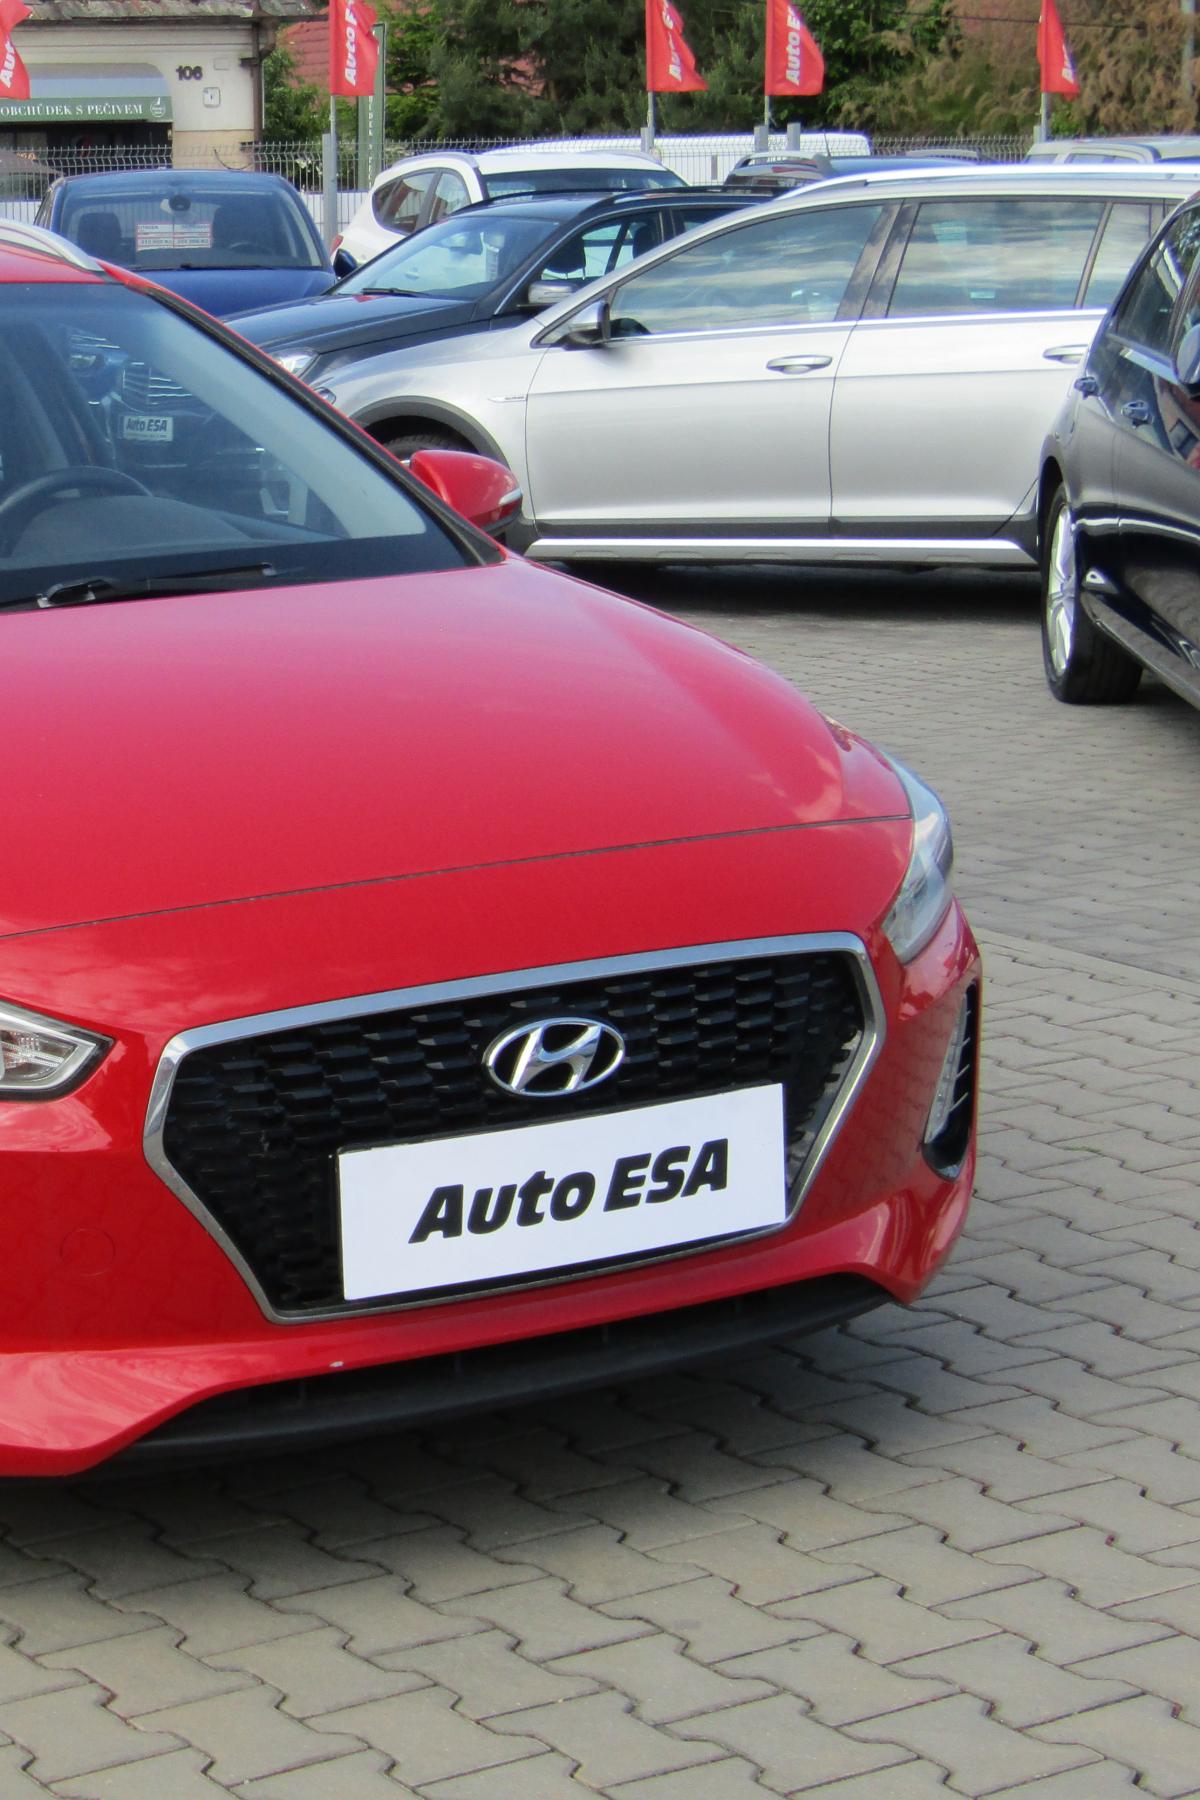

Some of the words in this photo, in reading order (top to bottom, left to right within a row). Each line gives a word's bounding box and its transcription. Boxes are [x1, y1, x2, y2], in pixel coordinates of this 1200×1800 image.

[785, 31, 801, 87] Auto
[0, 103, 72, 116] OBCHŮDEK
[75, 105, 83, 115] S
[87, 103, 143, 115] PEČIVEM
[126, 417, 146, 431] Auto
[147, 418, 167, 432] ESA
[408, 1170, 595, 1244] Auto
[603, 1138, 728, 1213] ESA
